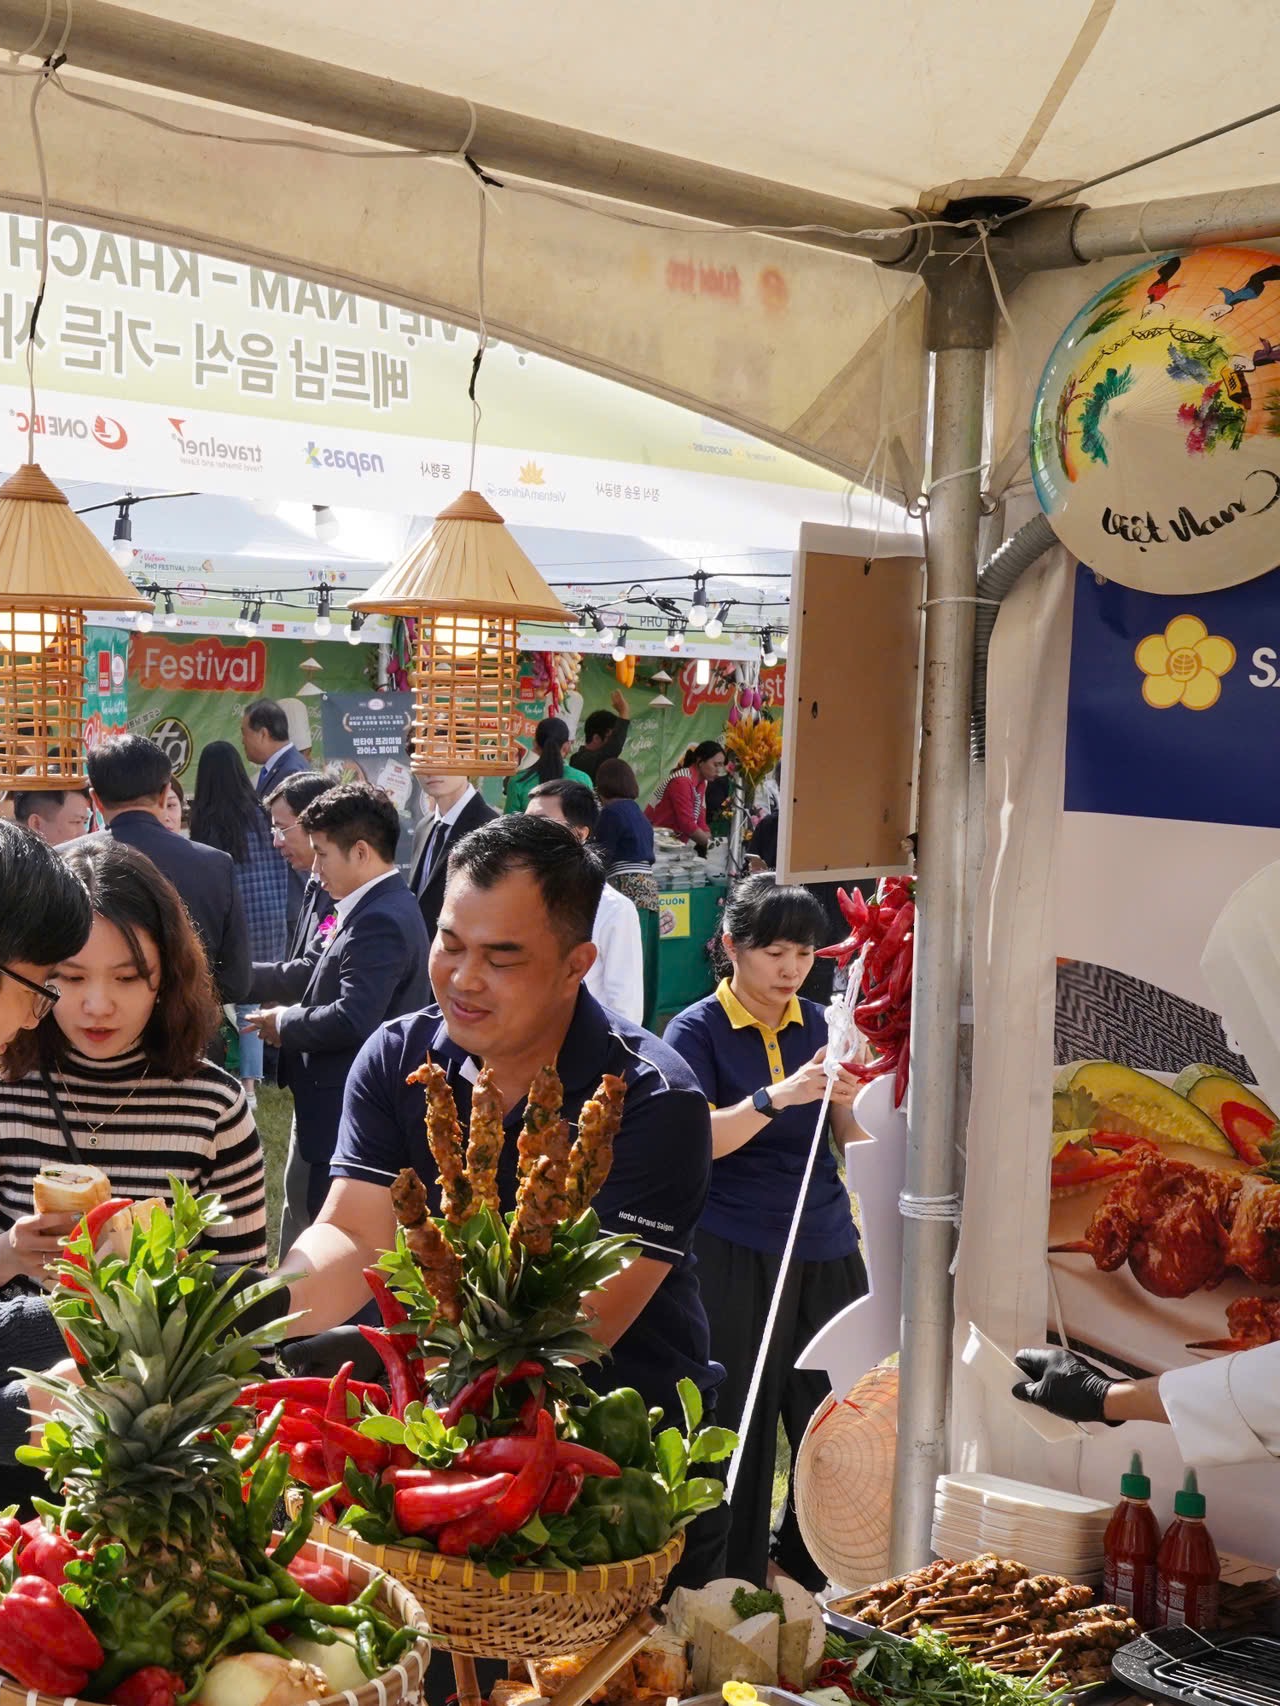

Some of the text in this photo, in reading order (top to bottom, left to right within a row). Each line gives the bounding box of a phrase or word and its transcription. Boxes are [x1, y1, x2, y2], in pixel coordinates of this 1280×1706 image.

[144, 648, 257, 683] Festival
[1249, 646, 1280, 688] S
[618, 1210, 675, 1232] Hotel Grand Saigon
